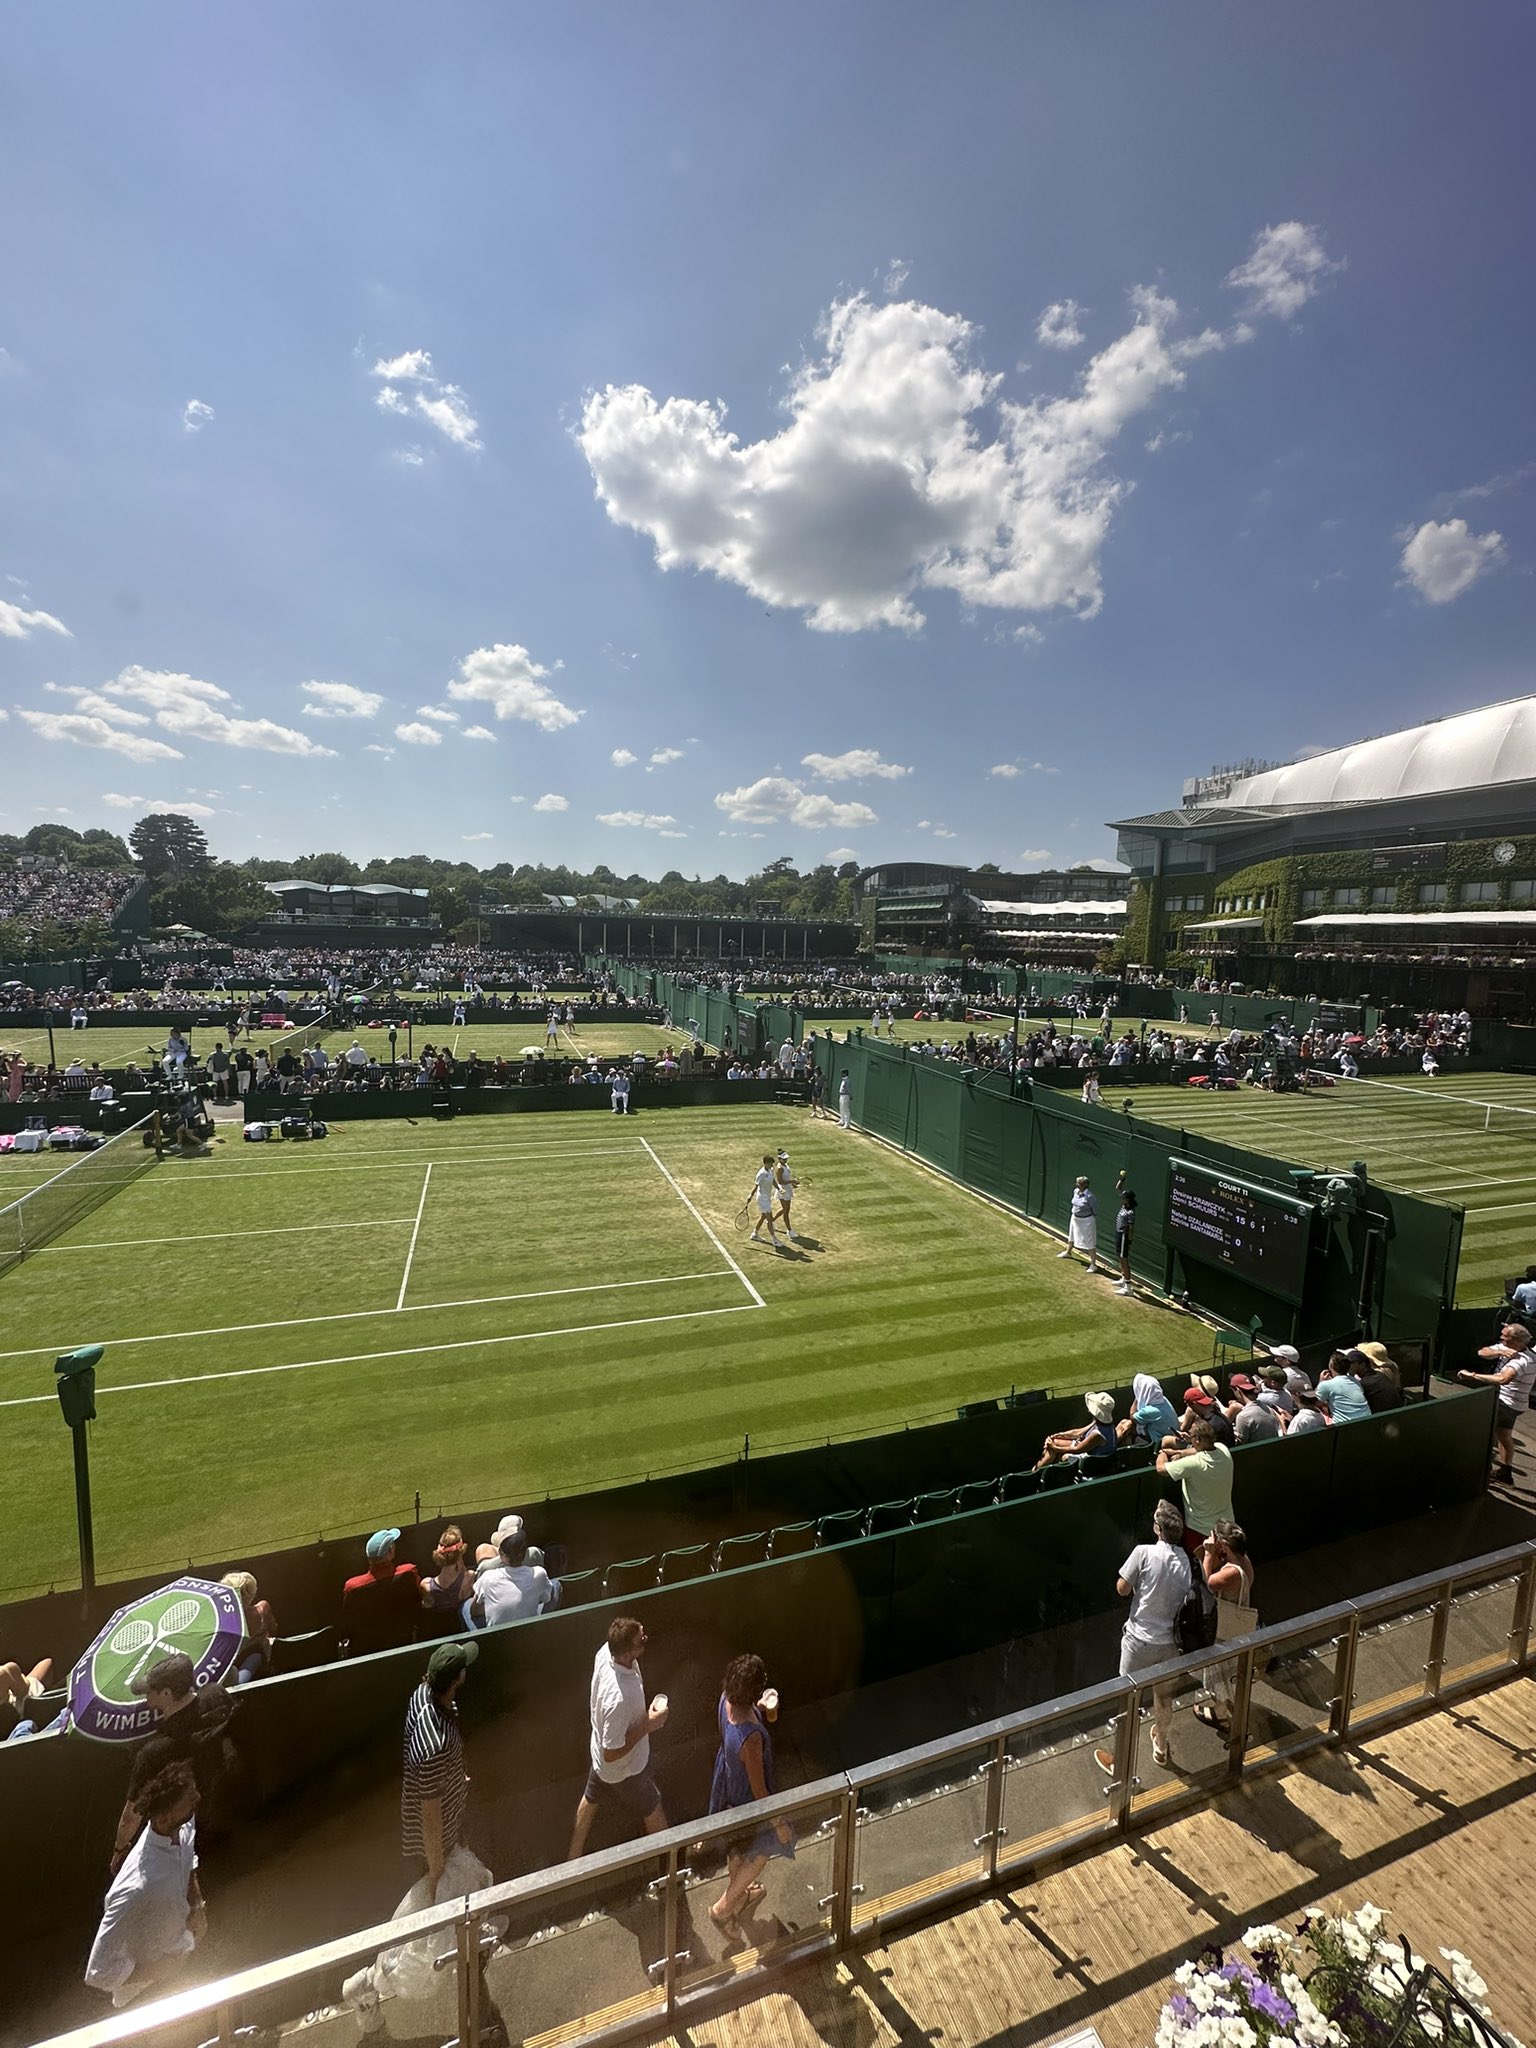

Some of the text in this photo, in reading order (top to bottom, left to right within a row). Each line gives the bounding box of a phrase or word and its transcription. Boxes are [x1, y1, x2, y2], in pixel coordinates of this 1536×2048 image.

[1218, 1181, 1241, 1193] COURT
[1220, 1191, 1244, 1205] ROLEX
[1235, 1215, 1246, 1225] 15
[1250, 1221, 1256, 1229] 6
[1235, 1238, 1242, 1246] 0
